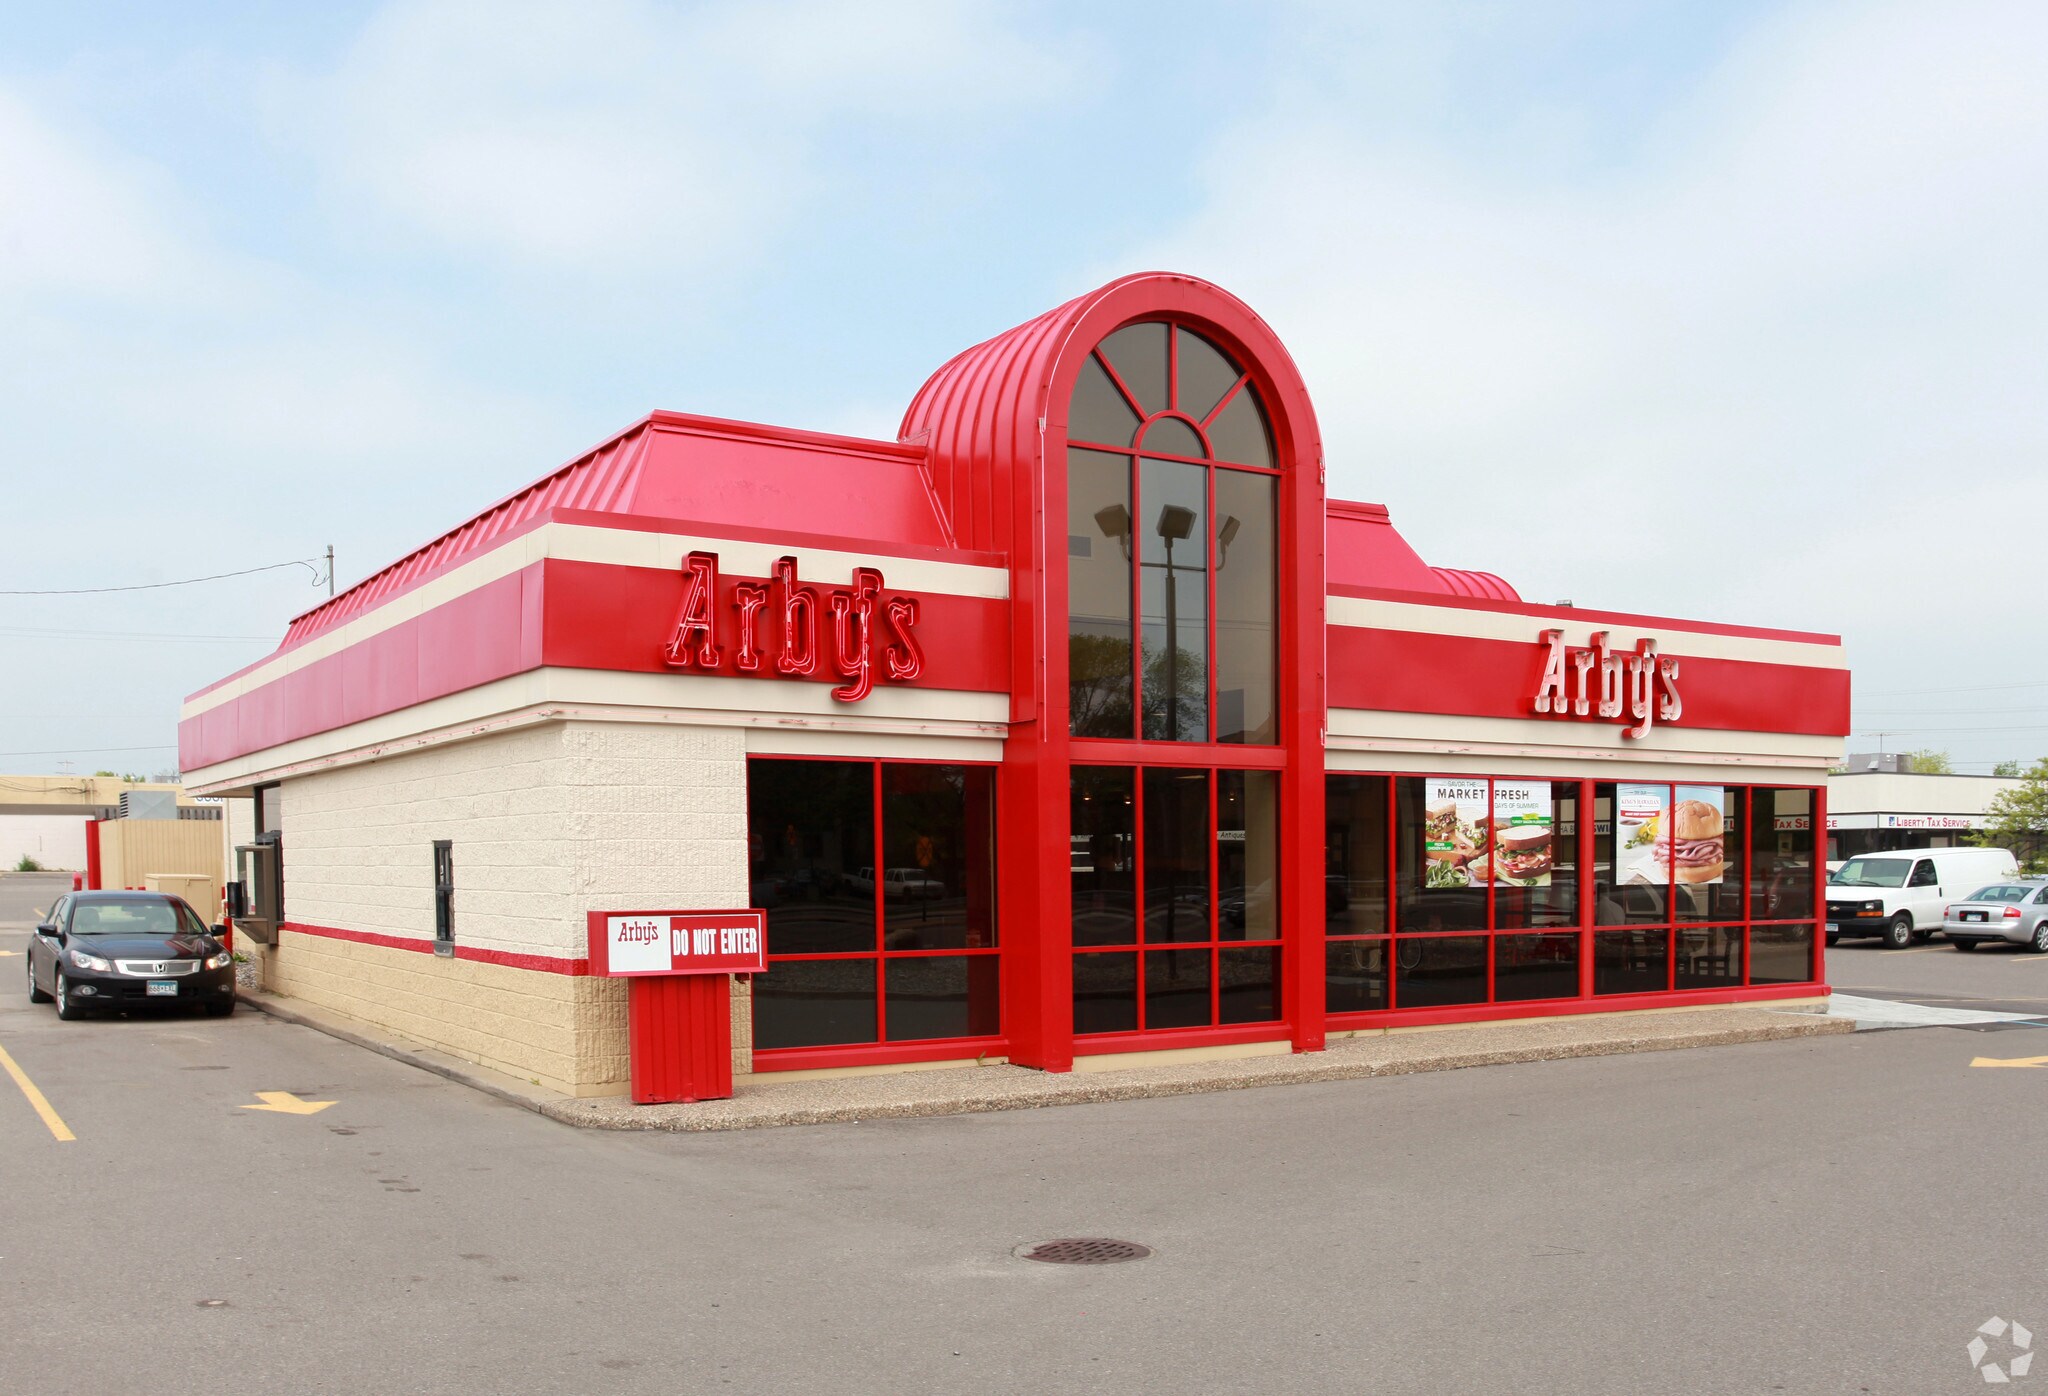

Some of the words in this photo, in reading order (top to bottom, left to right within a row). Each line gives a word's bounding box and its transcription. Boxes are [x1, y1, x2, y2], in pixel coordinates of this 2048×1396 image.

[664, 551, 925, 702] Arby's
[1529, 629, 1682, 740] Arby's
[1437, 788, 1486, 799] MARKET
[1495, 790, 1529, 800] FRESH
[1774, 819, 1792, 829] TAX
[1896, 817, 1925, 827] LIBERTY
[1927, 817, 1940, 827] TAX
[1942, 817, 1970, 827] SERVICE
[618, 921, 659, 946] Arby's
[673, 929, 689, 956] DO
[693, 928, 717, 955] NOT
[720, 928, 757, 954] ENTER
